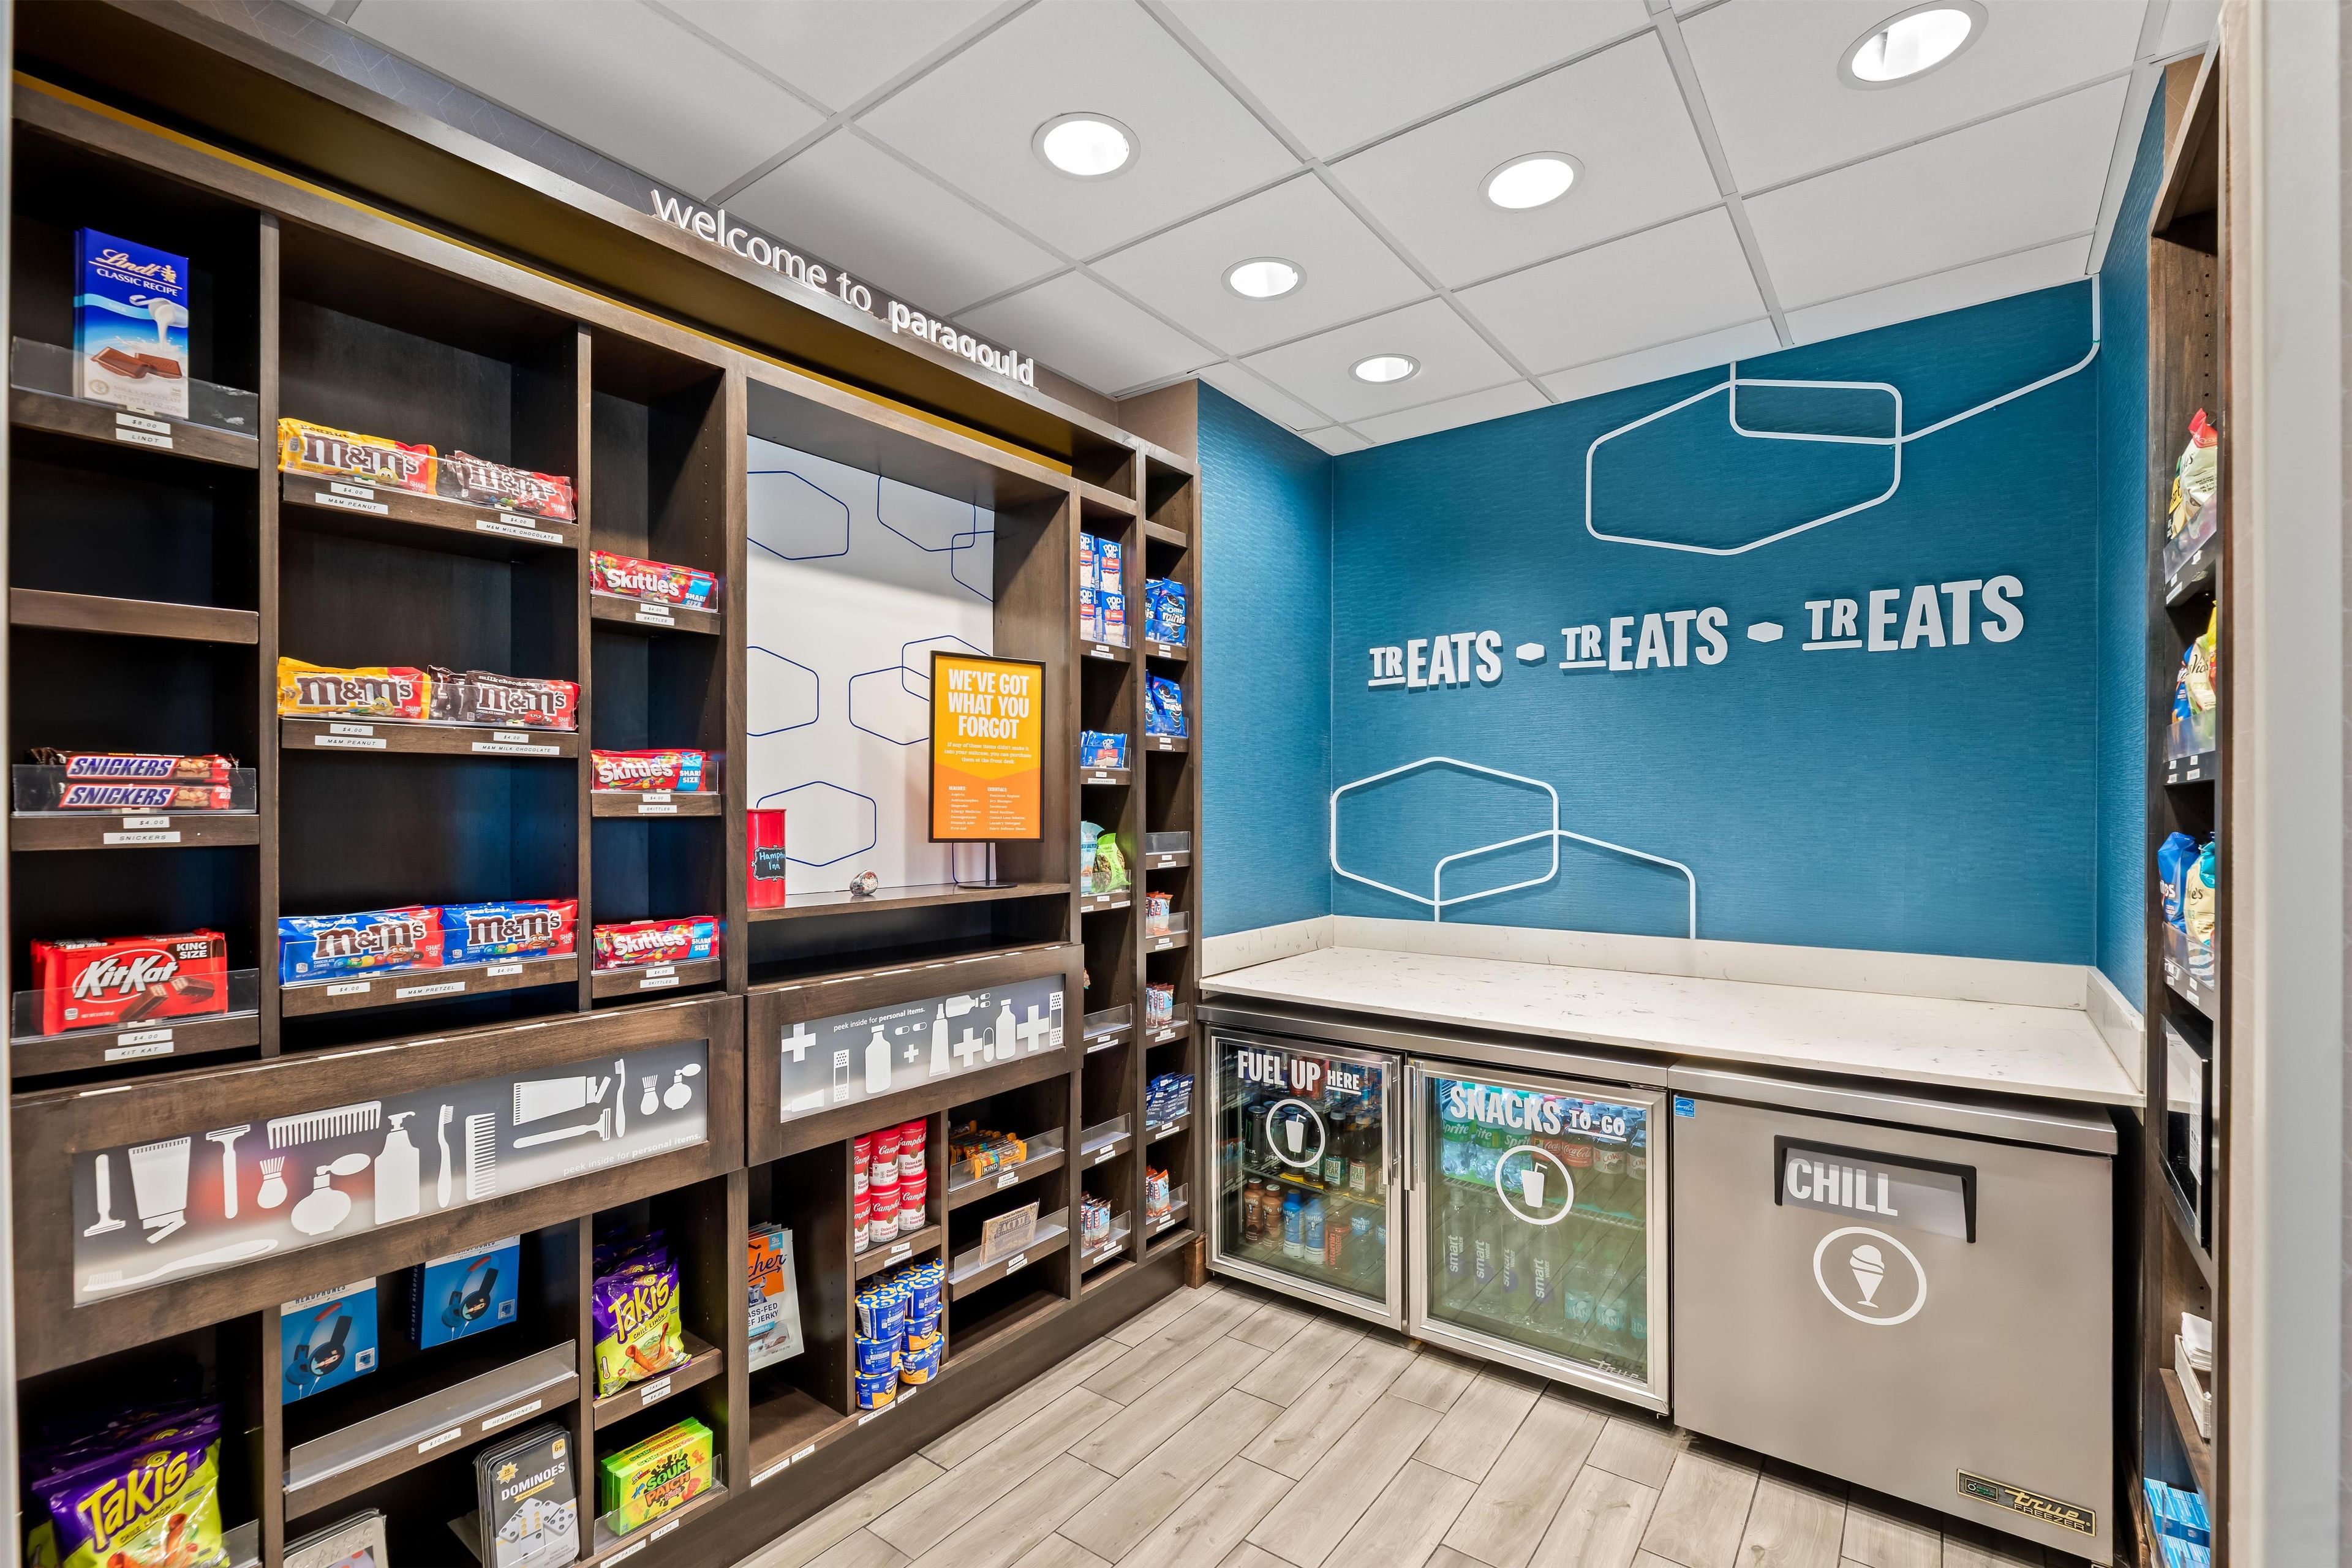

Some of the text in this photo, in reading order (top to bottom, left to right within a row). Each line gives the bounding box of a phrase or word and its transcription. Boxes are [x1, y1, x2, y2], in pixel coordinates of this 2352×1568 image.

[95, 249, 162, 276] Lindt
[97, 268, 178, 296] CLASSIC RECIPE
[650, 189, 1034, 388] welcome to paragould
[132, 434, 159, 443] LINDT
[348, 501, 377, 510] PEANUT
[519, 530, 554, 540] CHOCOLATE
[606, 568, 680, 597] Skittles
[1162, 612, 1186, 624] minis
[1368, 575, 2024, 688] TREATS TREATS TREATS
[948, 668, 1030, 696] WE'VE GOT
[948, 692, 1030, 718] WHAT YOU
[958, 715, 1019, 739] FORGOT
[69, 757, 172, 776] SNICKERS
[598, 761, 674, 784] Skittles
[66, 786, 172, 805] SNICKERS
[312, 920, 428, 960] m&m's
[467, 911, 562, 947] m&m's
[176, 942, 207, 951] KING
[179, 949, 207, 959] SIZE
[614, 932, 687, 956] Skittles
[834, 1007, 925, 1033] peek inside for personal items.
[134, 1033, 159, 1041] $4.00
[1237, 1050, 1360, 1091] FUEL UP HERE
[1450, 1086, 1626, 1137] SNACKS TO-GO
[564, 1133, 701, 1177] peek inside for personal items.
[984, 1163, 998, 1173] KIND
[1325, 1160, 1339, 1169] GOLD
[1351, 1165, 1363, 1174] GOLD
[1787, 1158, 1898, 1216] CHILL
[1001, 1219, 1016, 1232] ACT
[1447, 1235, 1459, 1273] smart
[1475, 1240, 1485, 1278] smart
[1534, 1257, 1545, 1298] smart
[608, 1274, 669, 1342] Takis
[758, 1310, 778, 1323] JERKY
[633, 1313, 665, 1340] CHILE LIMÓN
[649, 1382, 663, 1390] TAKIS
[650, 1391, 664, 1400] $4.00
[492, 1405, 533, 1425] HEADPHONES
[877, 1405, 891, 1414] CHEESE
[430, 1434, 452, 1447] $10.00
[500, 1461, 566, 1501] DOMINOES
[631, 1471, 643, 1480] SOUR
[646, 1459, 688, 1492] SOUR
[78, 1451, 188, 1550] Takis
[644, 1471, 690, 1507] PATCH
[2004, 1489, 2086, 1525] true
[2014, 1503, 2085, 1531] FREEZER
[605, 1545, 639, 1566] SOUR PATCH
